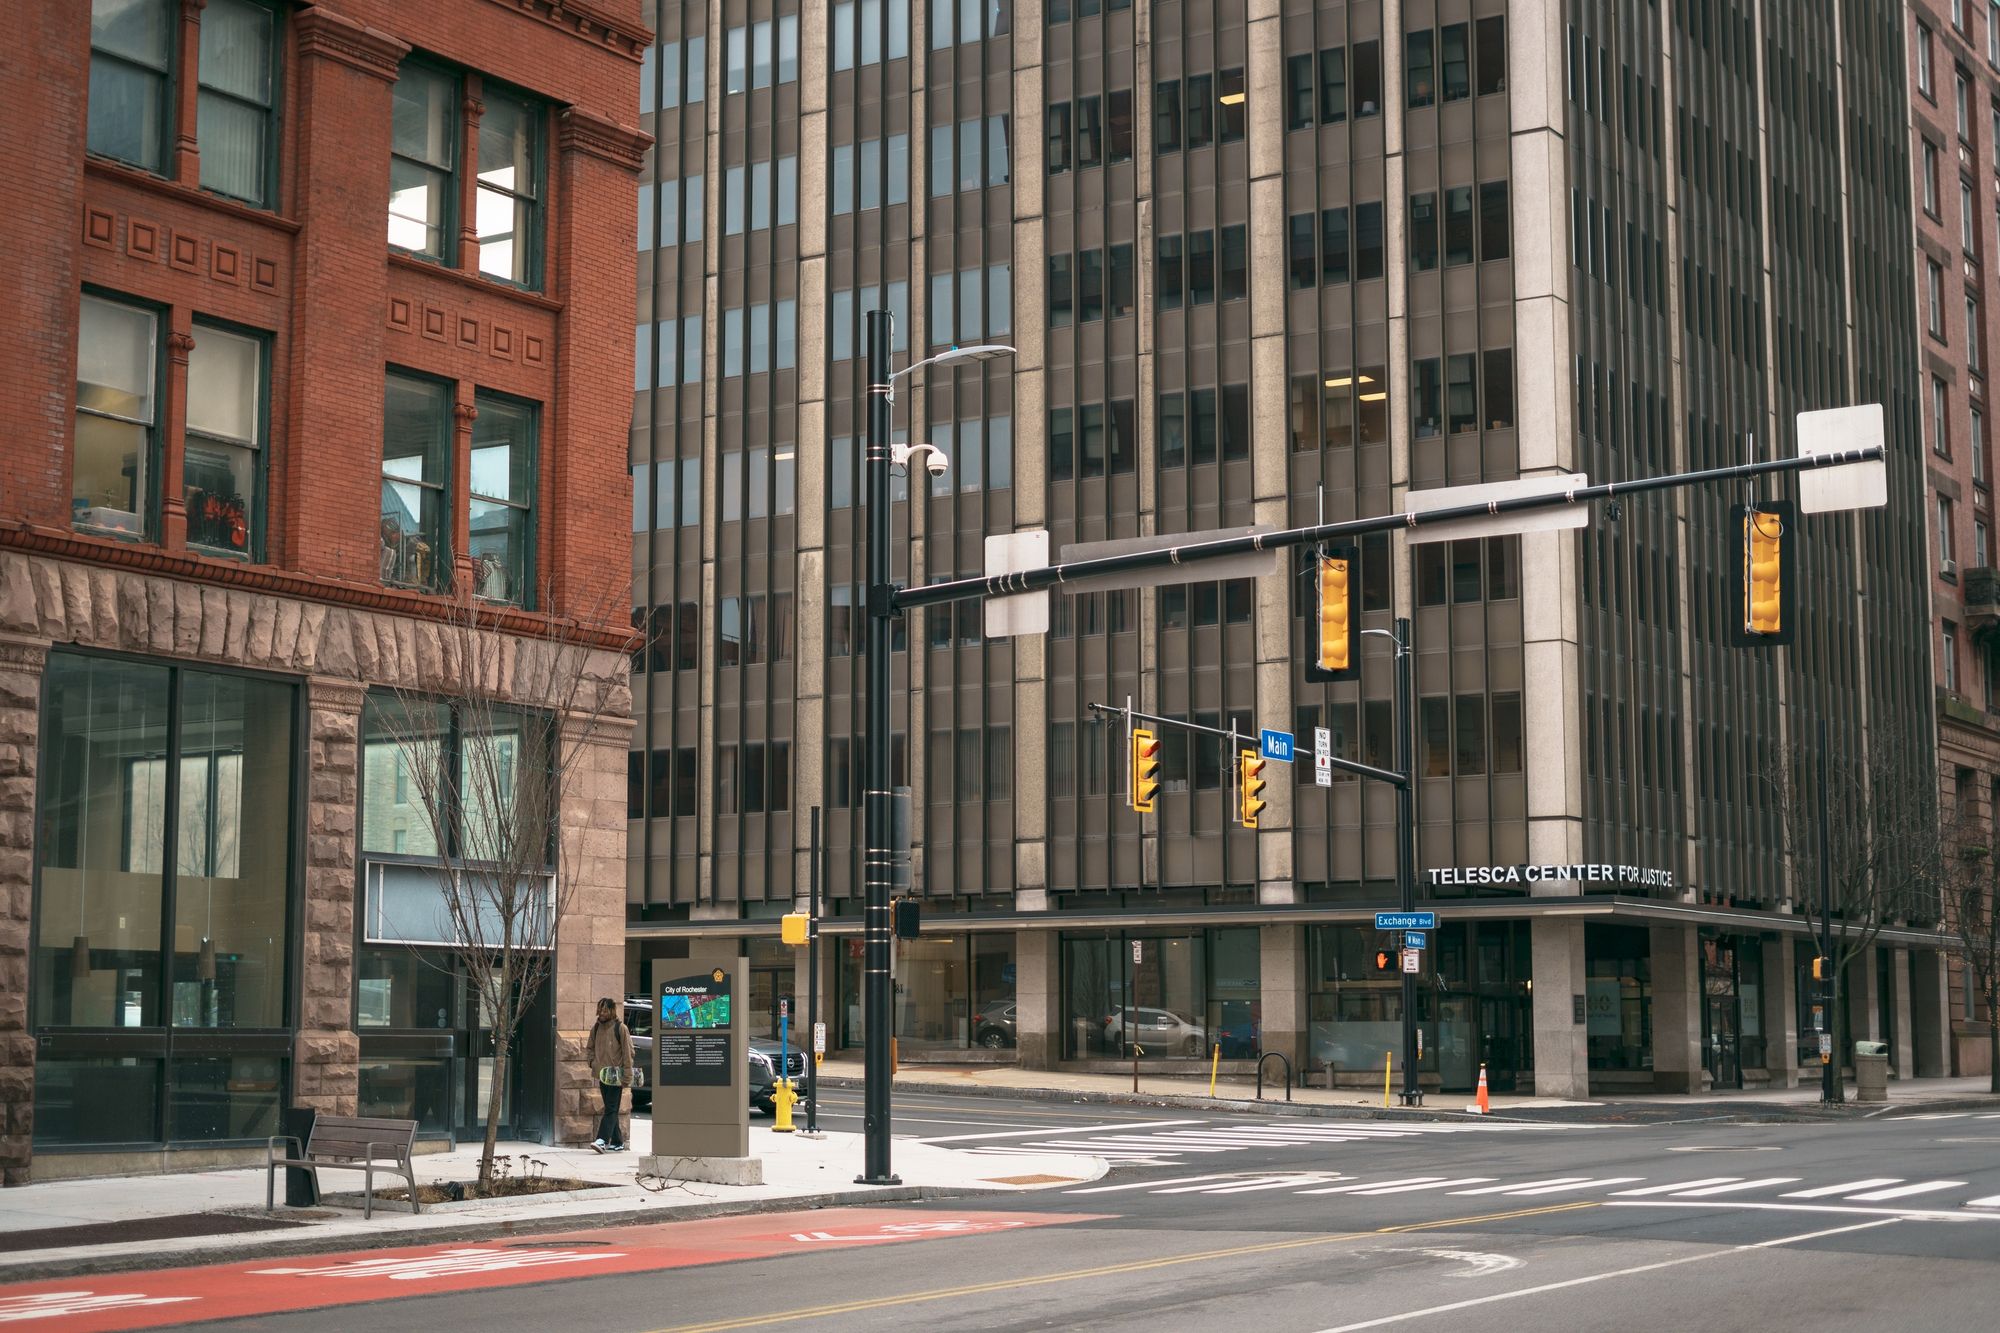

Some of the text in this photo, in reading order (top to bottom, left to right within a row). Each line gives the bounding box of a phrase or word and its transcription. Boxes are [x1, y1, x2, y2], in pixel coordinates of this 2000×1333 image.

[1268, 735, 1288, 756] Main
[1428, 864, 1672, 887] TELESCA CENTER FOR JUSTICE
[1378, 916, 1417, 928] Exchange
[665, 986, 676, 994] City
